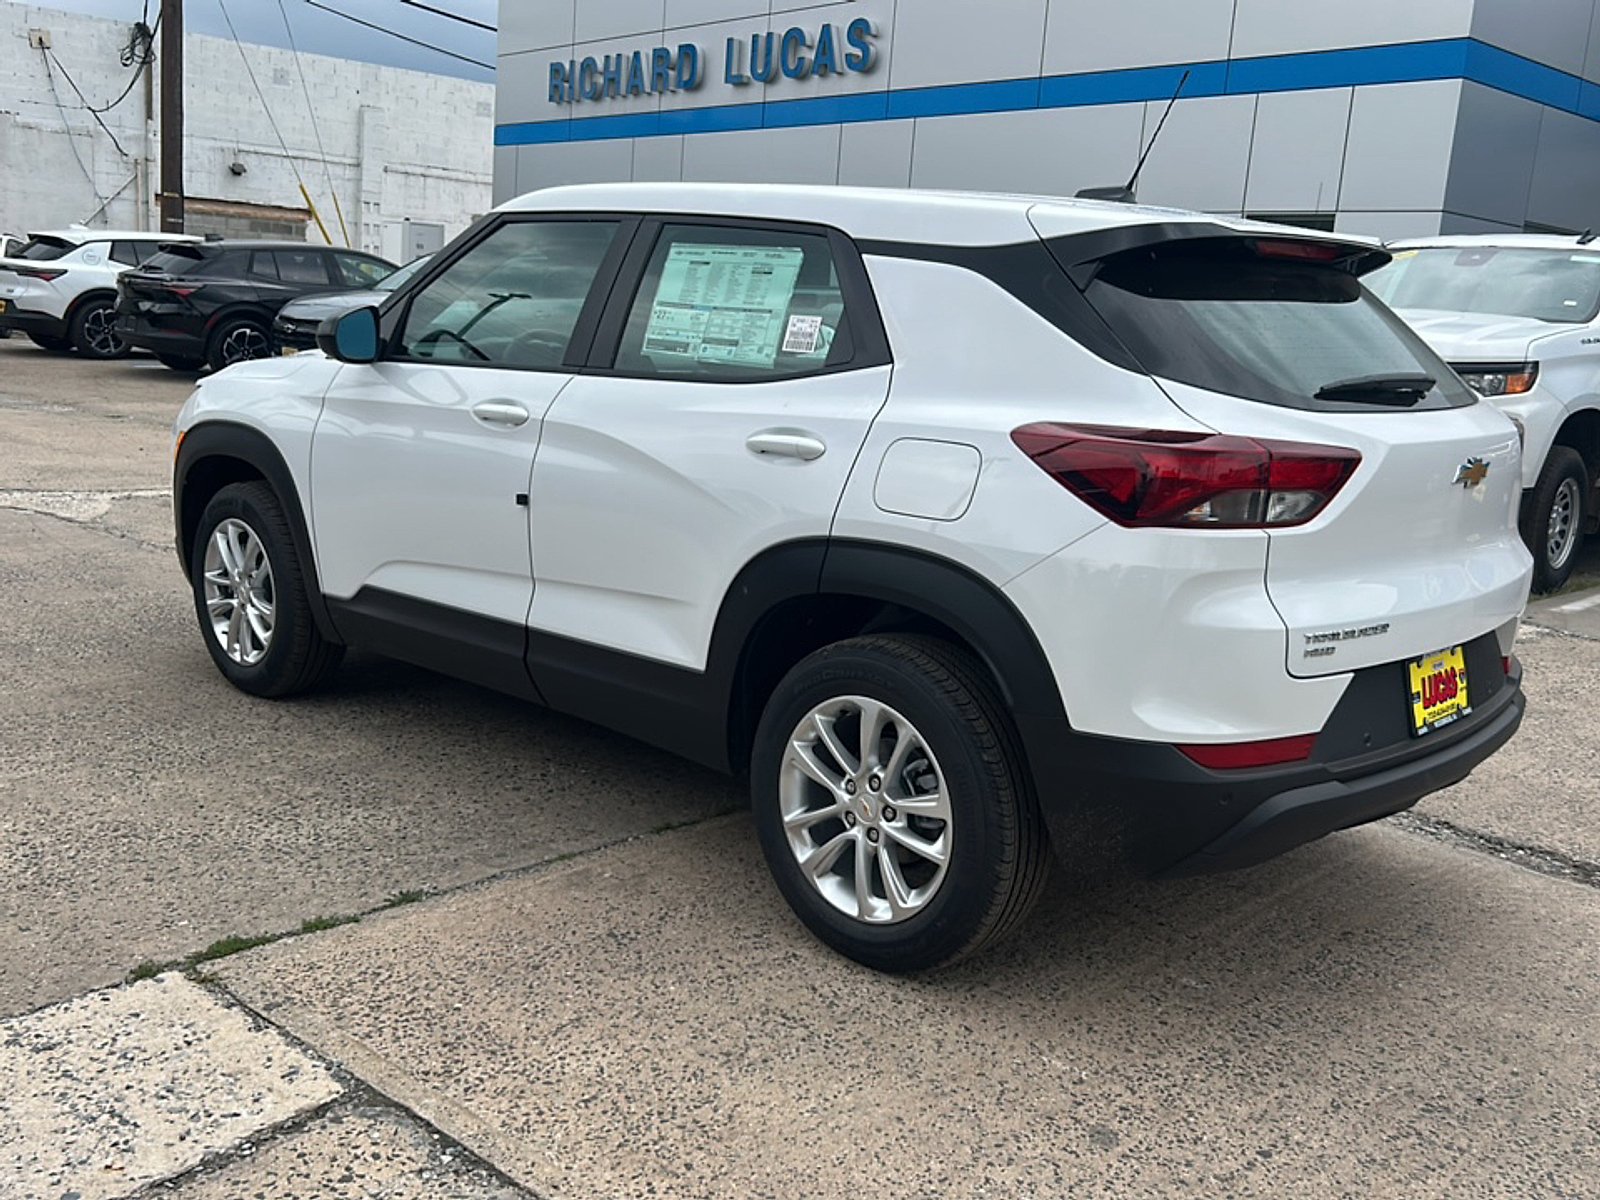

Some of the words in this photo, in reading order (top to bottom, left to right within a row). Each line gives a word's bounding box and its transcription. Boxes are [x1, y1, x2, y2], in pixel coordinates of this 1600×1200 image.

[549, 43, 704, 104] RICHARD
[724, 17, 880, 86] LUCAS
[1421, 666, 1458, 710] LUCAS
